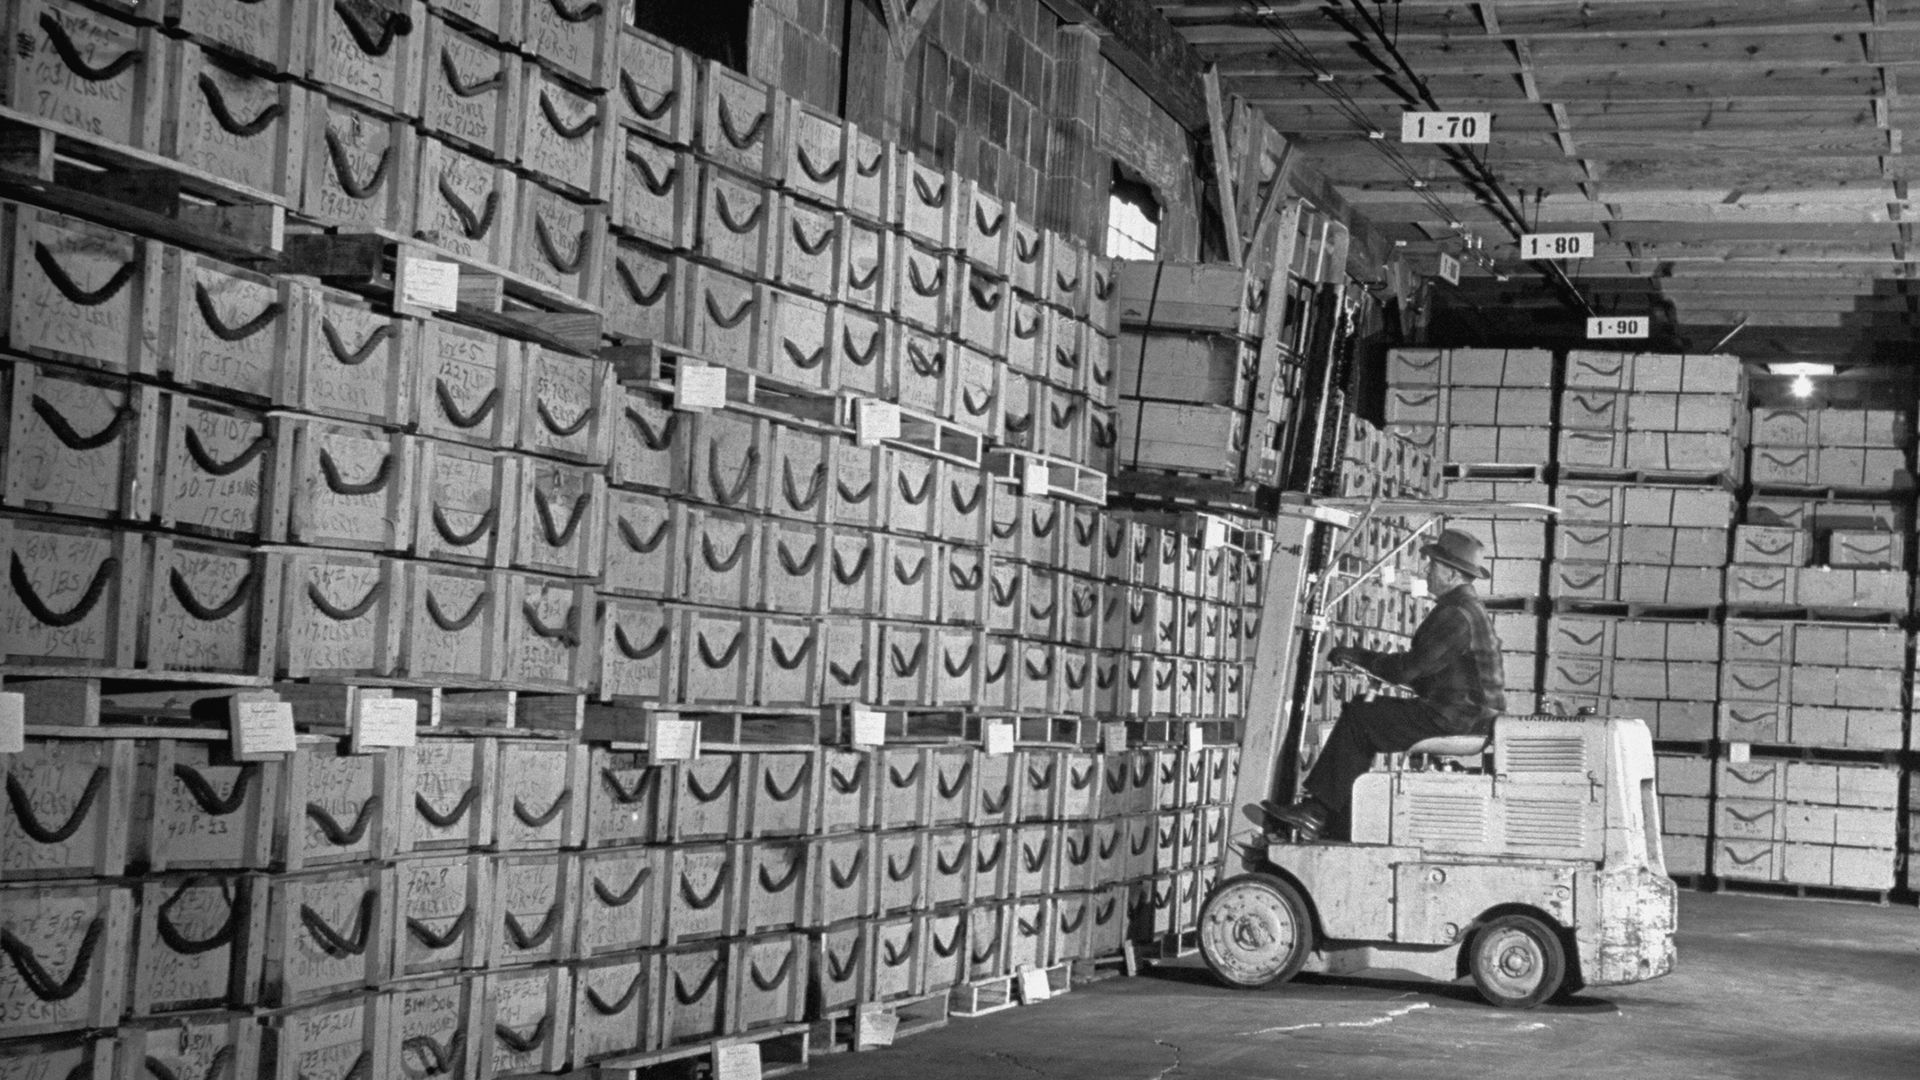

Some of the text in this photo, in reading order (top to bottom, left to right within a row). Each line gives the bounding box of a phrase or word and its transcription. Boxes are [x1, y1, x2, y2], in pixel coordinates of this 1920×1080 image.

[1418, 116, 1476, 138] 1-70
[1531, 236, 1580, 255] 1-80
[1597, 320, 1638, 335] 1-90
